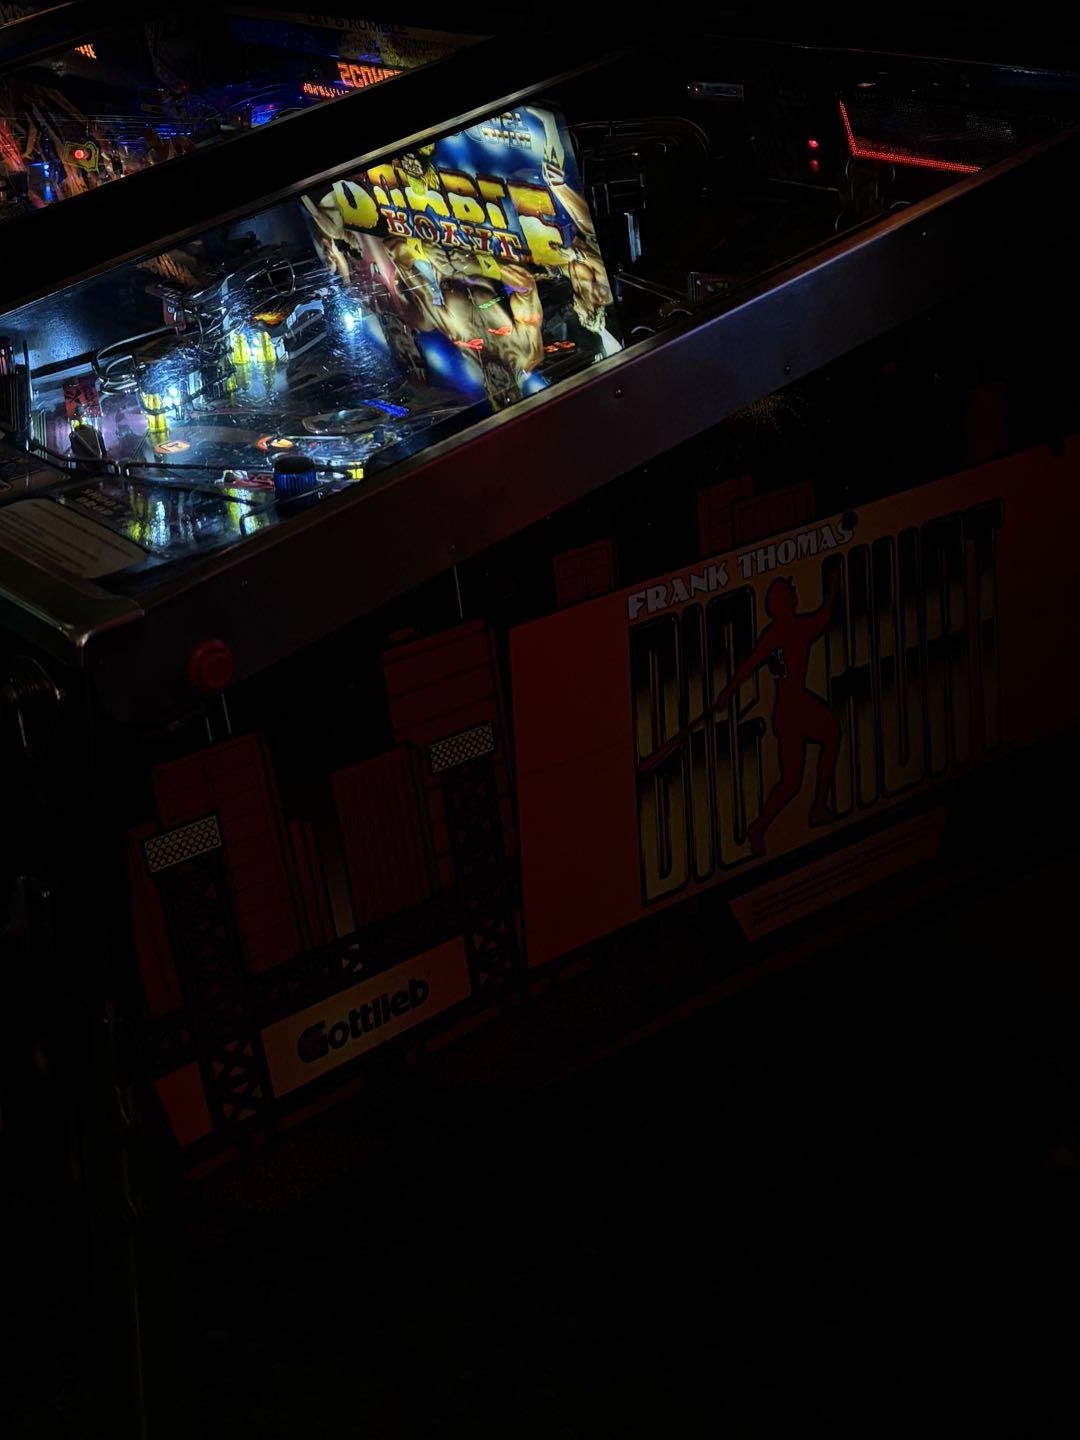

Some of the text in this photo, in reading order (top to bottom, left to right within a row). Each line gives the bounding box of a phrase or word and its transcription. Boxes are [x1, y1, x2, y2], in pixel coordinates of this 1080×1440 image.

[626, 521, 855, 621] FRANK THOMAS
[628, 496, 1006, 909] BIG HURT
[297, 978, 430, 1064] Gottlieb
